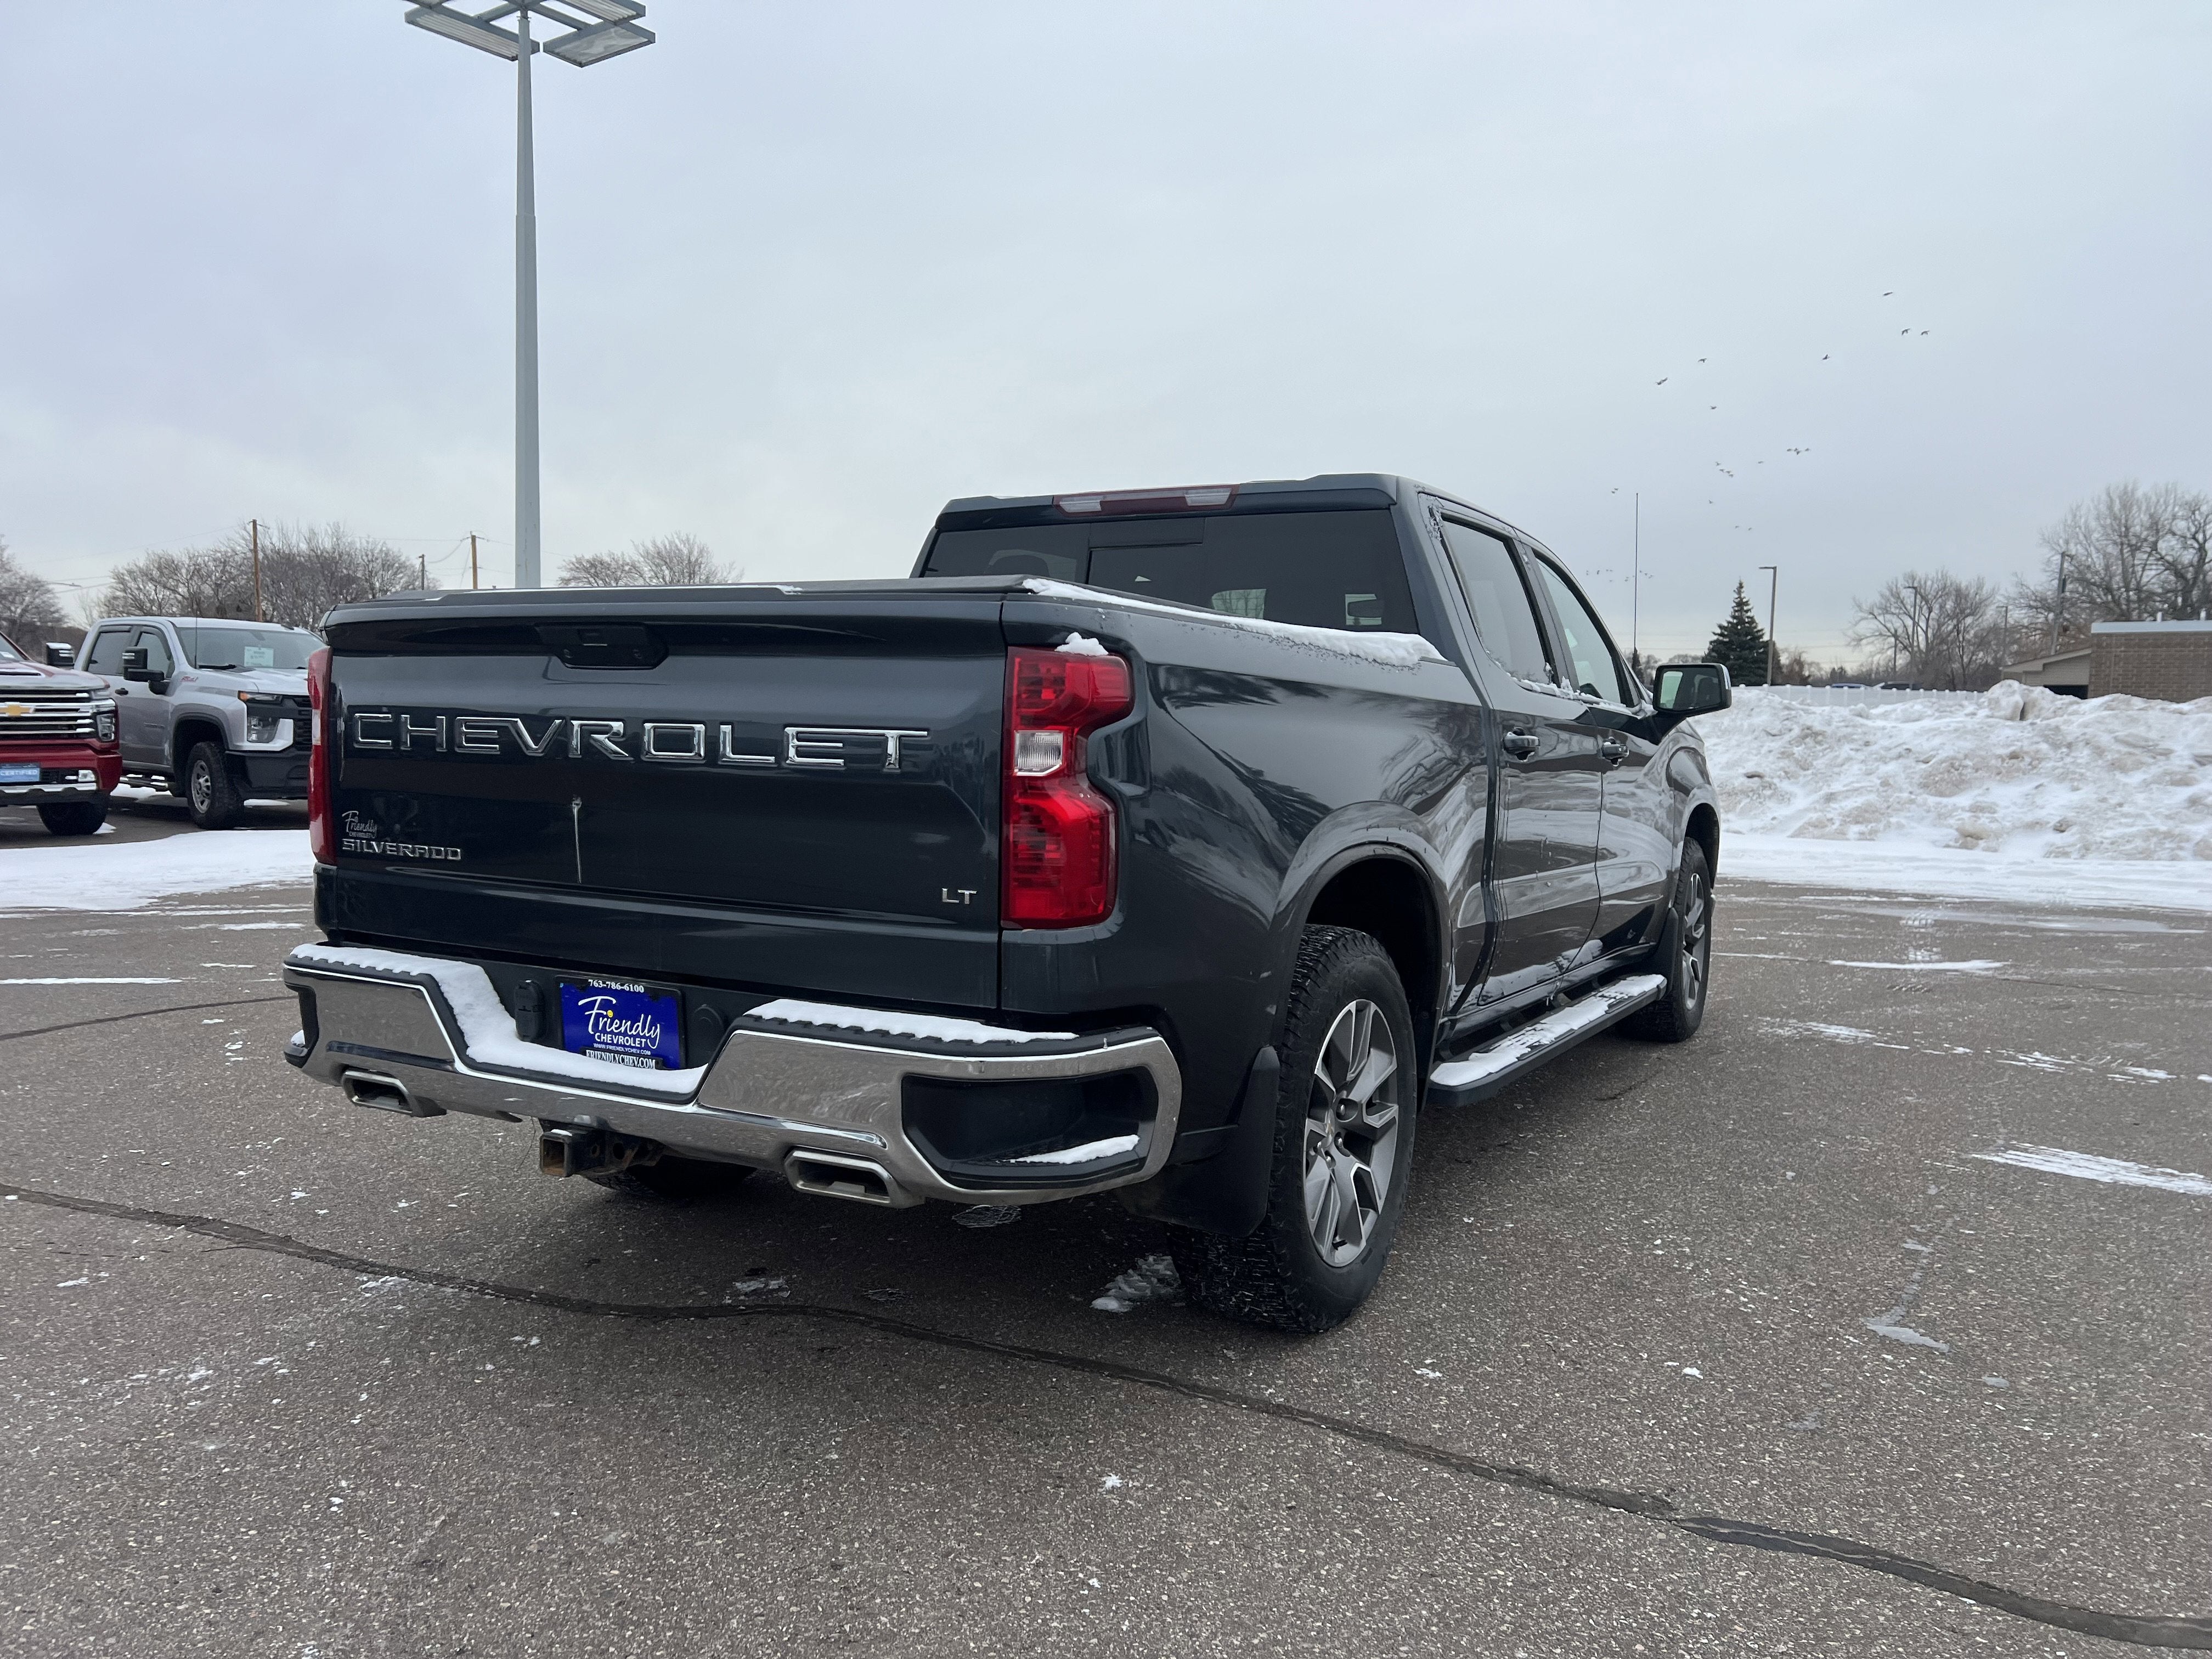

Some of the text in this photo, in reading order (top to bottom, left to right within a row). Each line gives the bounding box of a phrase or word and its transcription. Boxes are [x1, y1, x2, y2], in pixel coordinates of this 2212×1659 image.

[353, 713, 929, 772] CHEVROLET
[342, 838, 461, 861] SILVERADO
[942, 888, 977, 905] LT
[588, 979, 645, 993] 763-786-6100
[578, 996, 660, 1049] Friendly
[595, 1032, 646, 1047] CHEVROLET
[586, 1049, 656, 1069] FRIENDLYCHEV.COM
